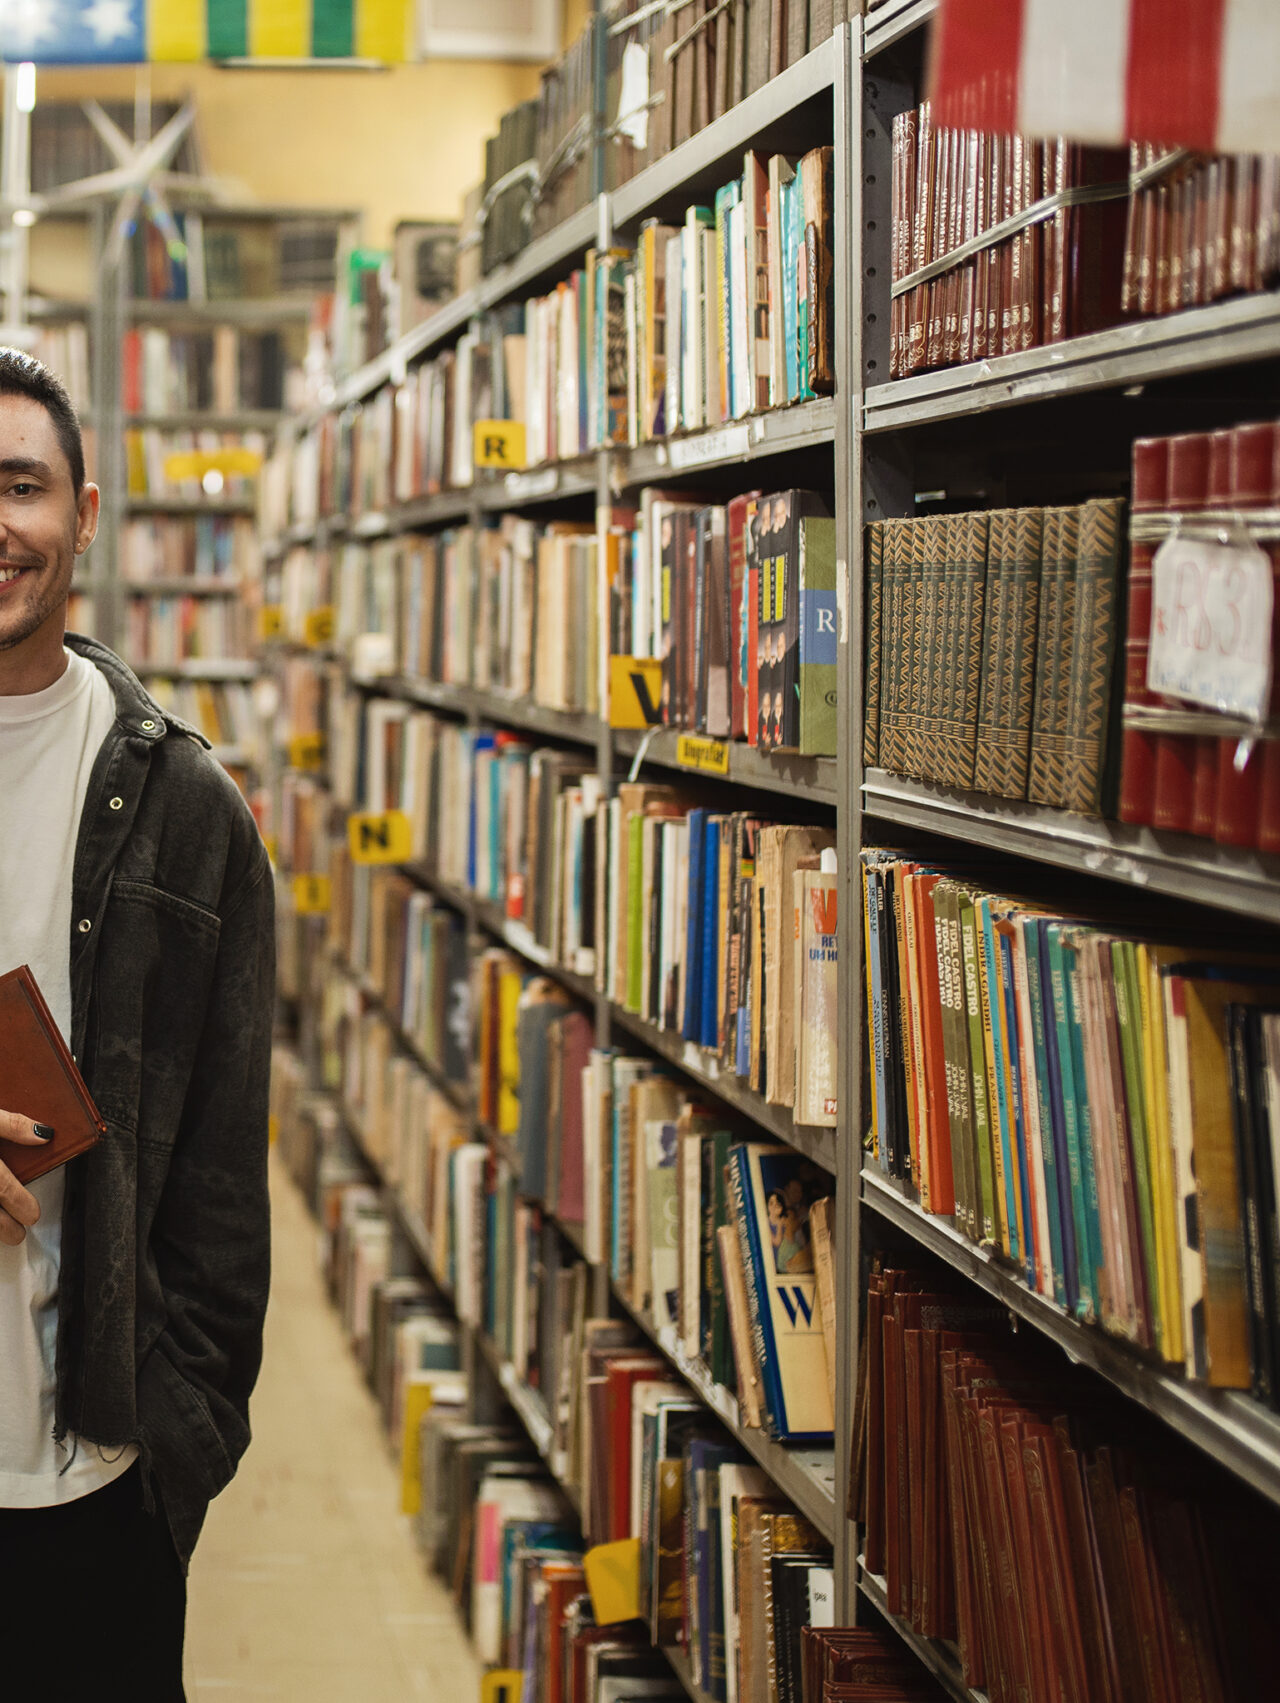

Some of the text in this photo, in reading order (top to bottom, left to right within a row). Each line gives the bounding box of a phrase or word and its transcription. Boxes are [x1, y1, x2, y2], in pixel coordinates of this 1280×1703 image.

[485, 436, 509, 459] R
[817, 607, 835, 633] R
[942, 919, 951, 950] FIDEL
[949, 920, 959, 952] FIDEL
[962, 925, 974, 960] FIDEL
[943, 951, 954, 1009] CASTRO
[950, 953, 962, 1011] CASTRO
[965, 963, 979, 1017] CASTRO
[978, 930, 986, 978] INDIRA
[982, 980, 991, 1033] GANDHI
[958, 1067, 967, 1088] JOHN
[973, 1072, 984, 1099] JOHN
[776, 1286, 817, 1328] W
